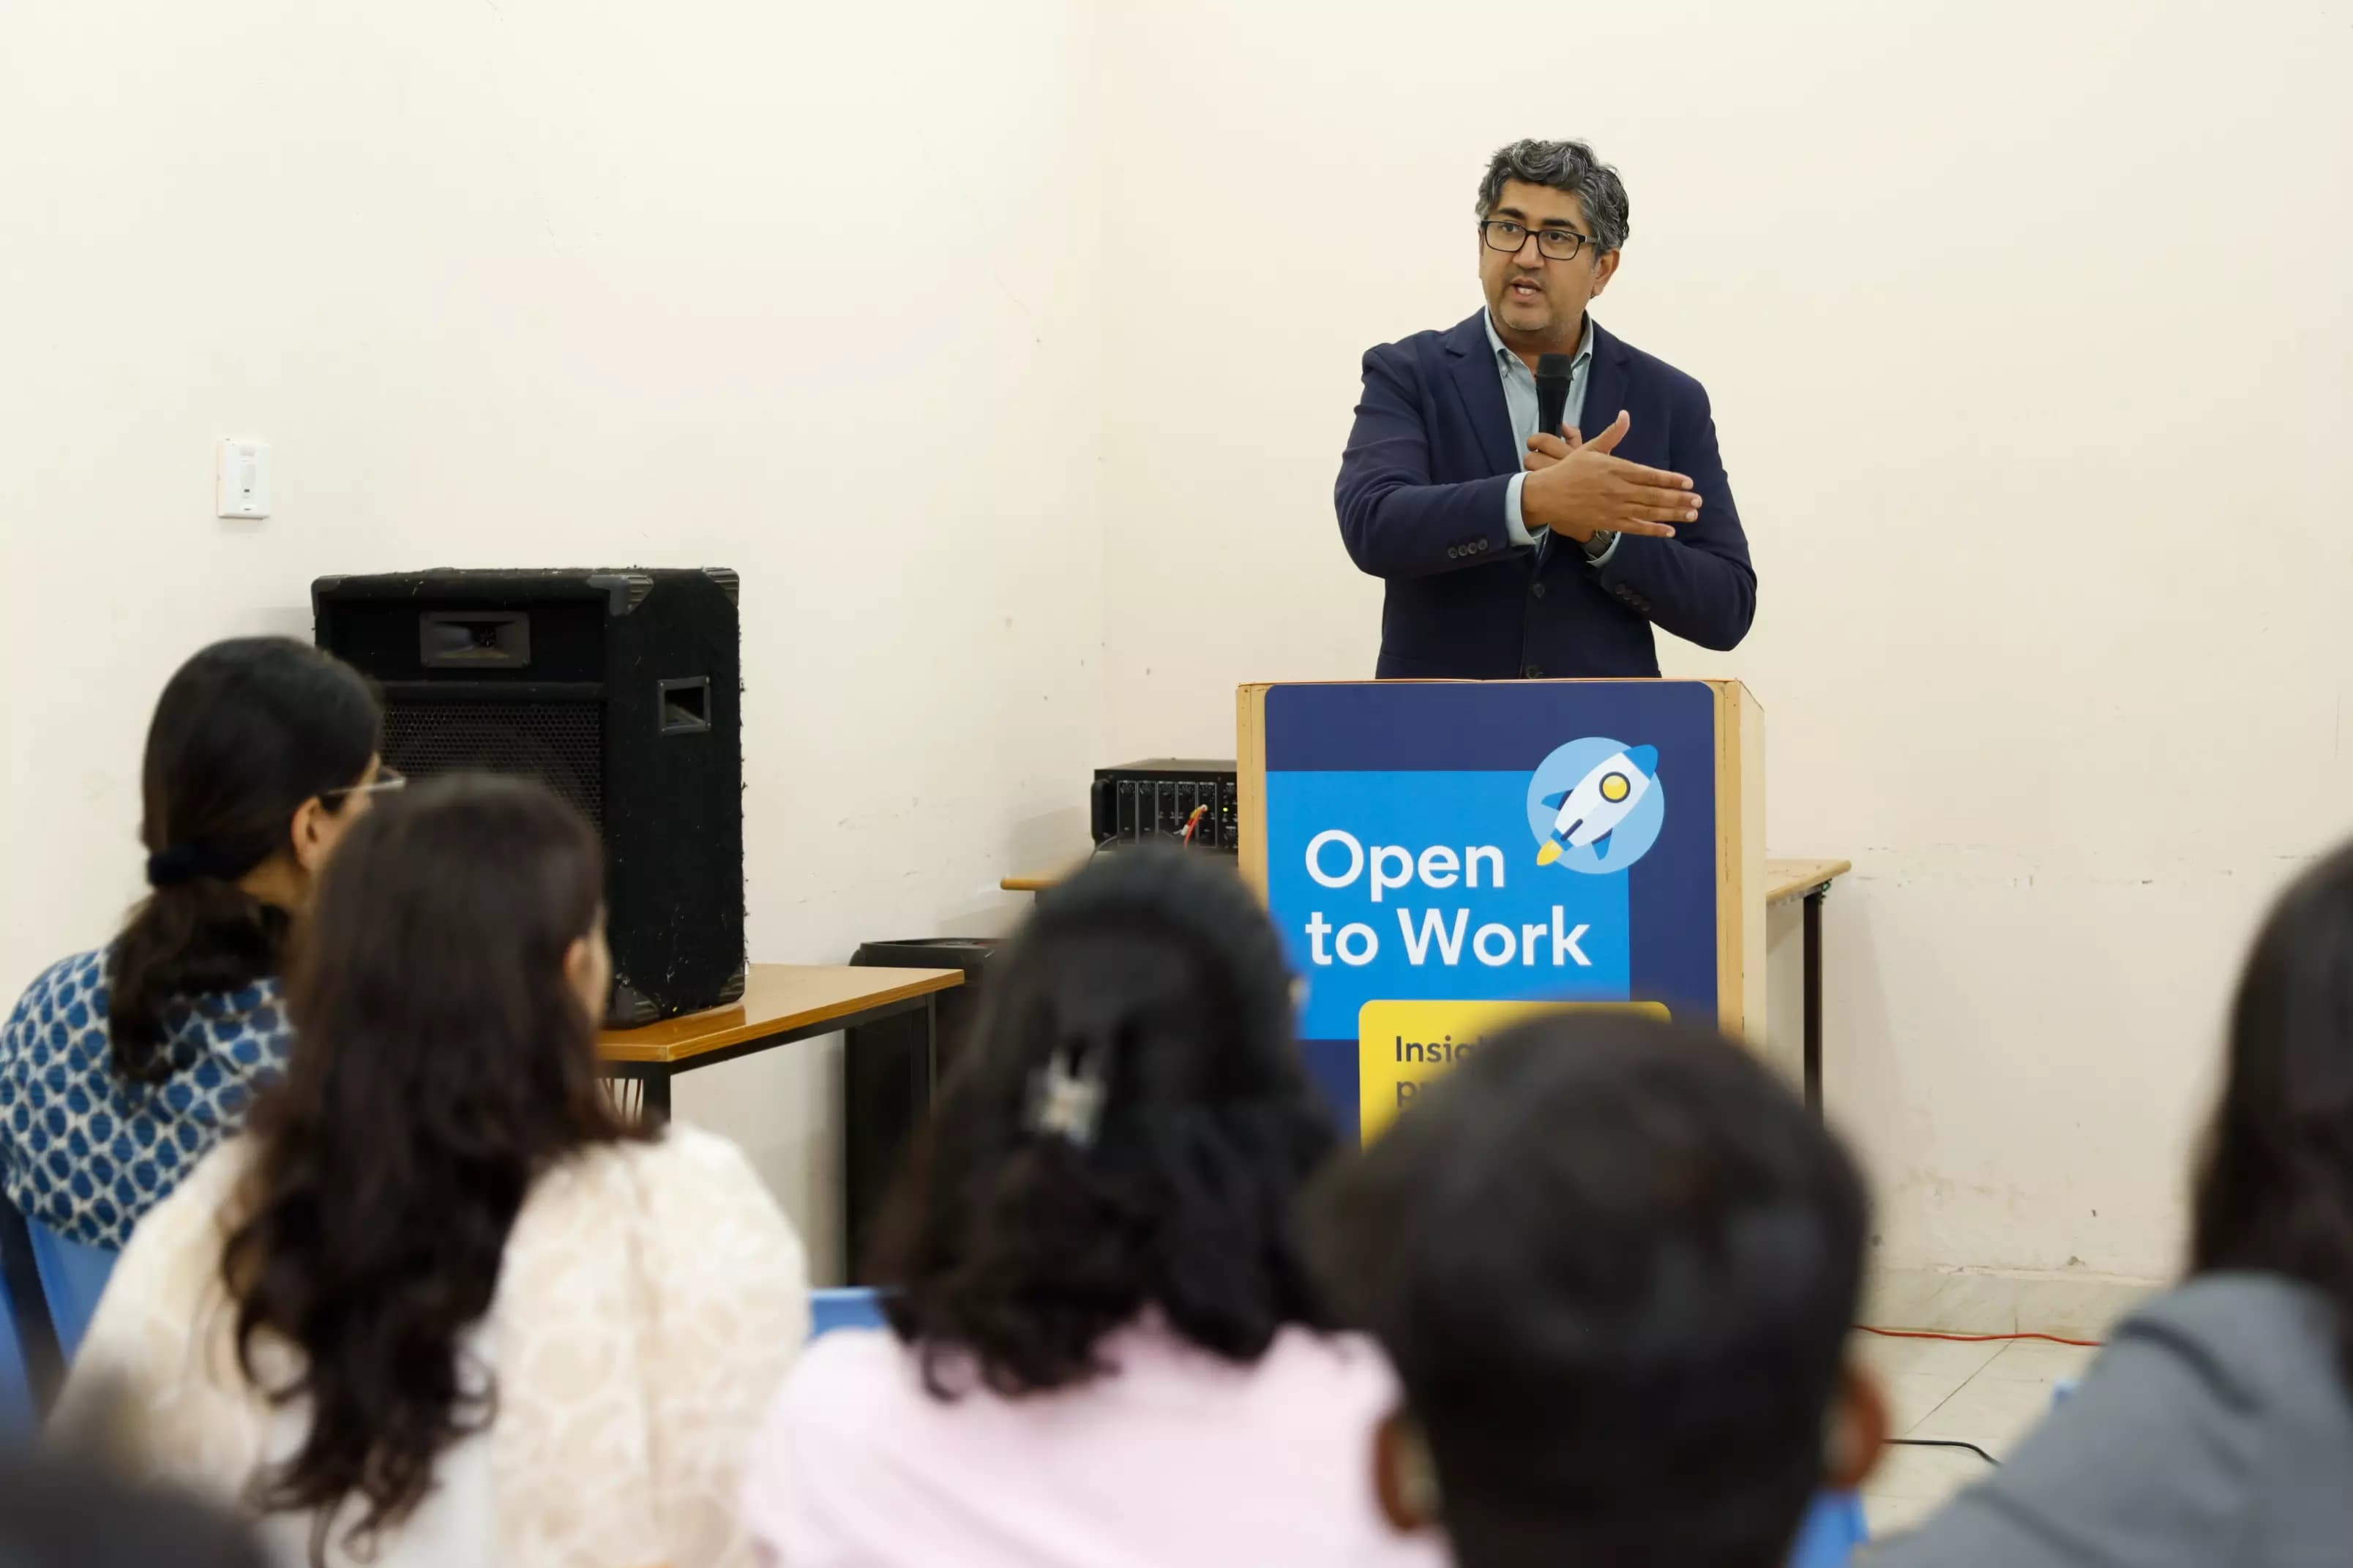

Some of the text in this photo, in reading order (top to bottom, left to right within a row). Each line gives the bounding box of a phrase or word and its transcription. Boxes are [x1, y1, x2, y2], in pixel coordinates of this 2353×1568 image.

[1305, 829, 1505, 902] Open
[1305, 904, 1592, 967] to Work
